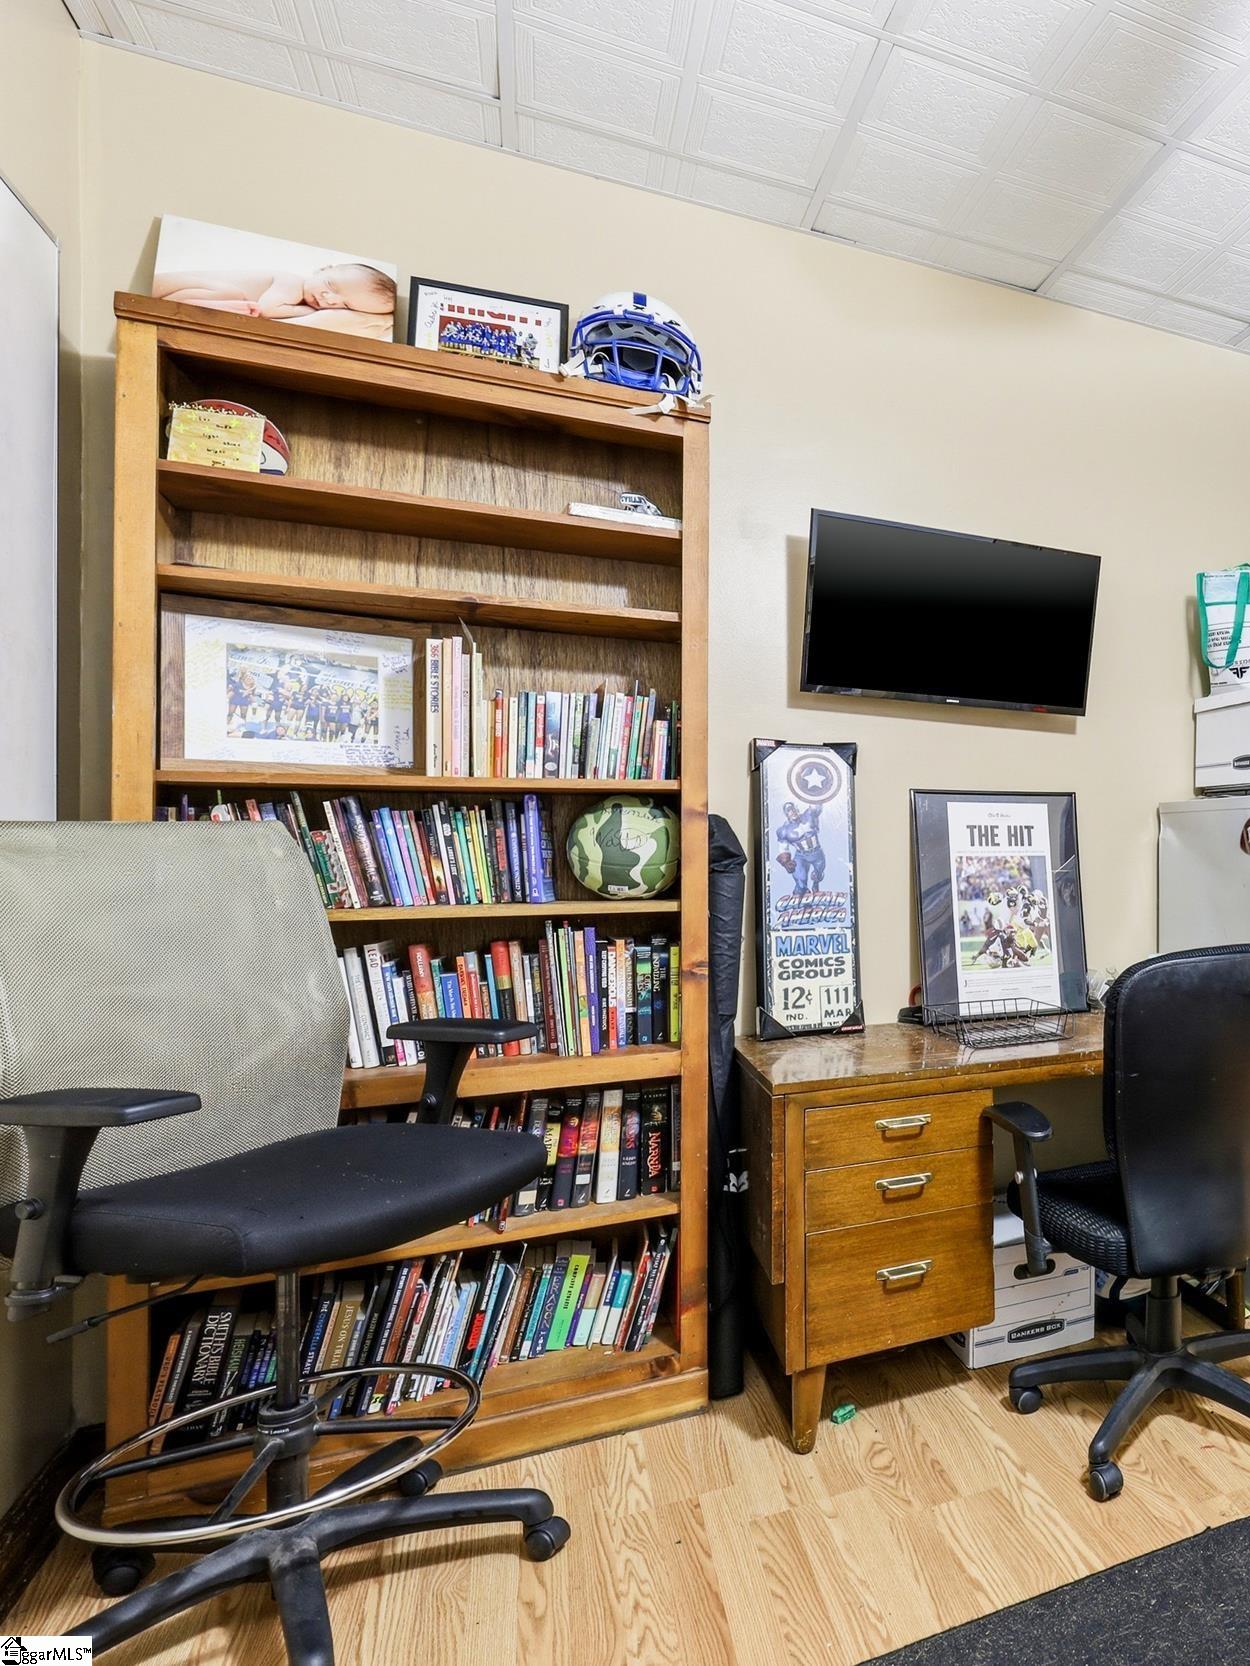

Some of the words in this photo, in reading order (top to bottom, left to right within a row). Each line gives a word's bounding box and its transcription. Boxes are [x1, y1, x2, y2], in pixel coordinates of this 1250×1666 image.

[429, 644, 440, 658] 366
[430, 659, 440, 682] BIBLE
[430, 682, 440, 714] STORIES
[966, 825, 1000, 847] THE
[1007, 825, 1034, 847] HIT
[775, 891, 847, 912] CAPTAIN
[776, 908, 847, 927] AMERICA
[775, 933, 850, 957] MARVEL
[369, 948, 379, 968] LEAD
[778, 956, 846, 969] COMICS
[608, 951, 617, 1007] DANGEROUS
[778, 968, 846, 980] GROUP
[824, 986, 849, 1005] 111
[824, 1008, 852, 1018] MAR
[646, 1131, 661, 1178] NARNIA
[340, 1304, 353, 1329] JESUS
[210, 1310, 232, 1354] SMITH'S
[1010, 1326, 1045, 1340] BANKERS
[1046, 1323, 1061, 1331] BOX
[190, 1313, 220, 1383] DICTIONARY
[330, 1342, 343, 1368] TRIAL
[202, 1353, 221, 1386] BIBLE
[301, 1350, 315, 1375] STRATE
